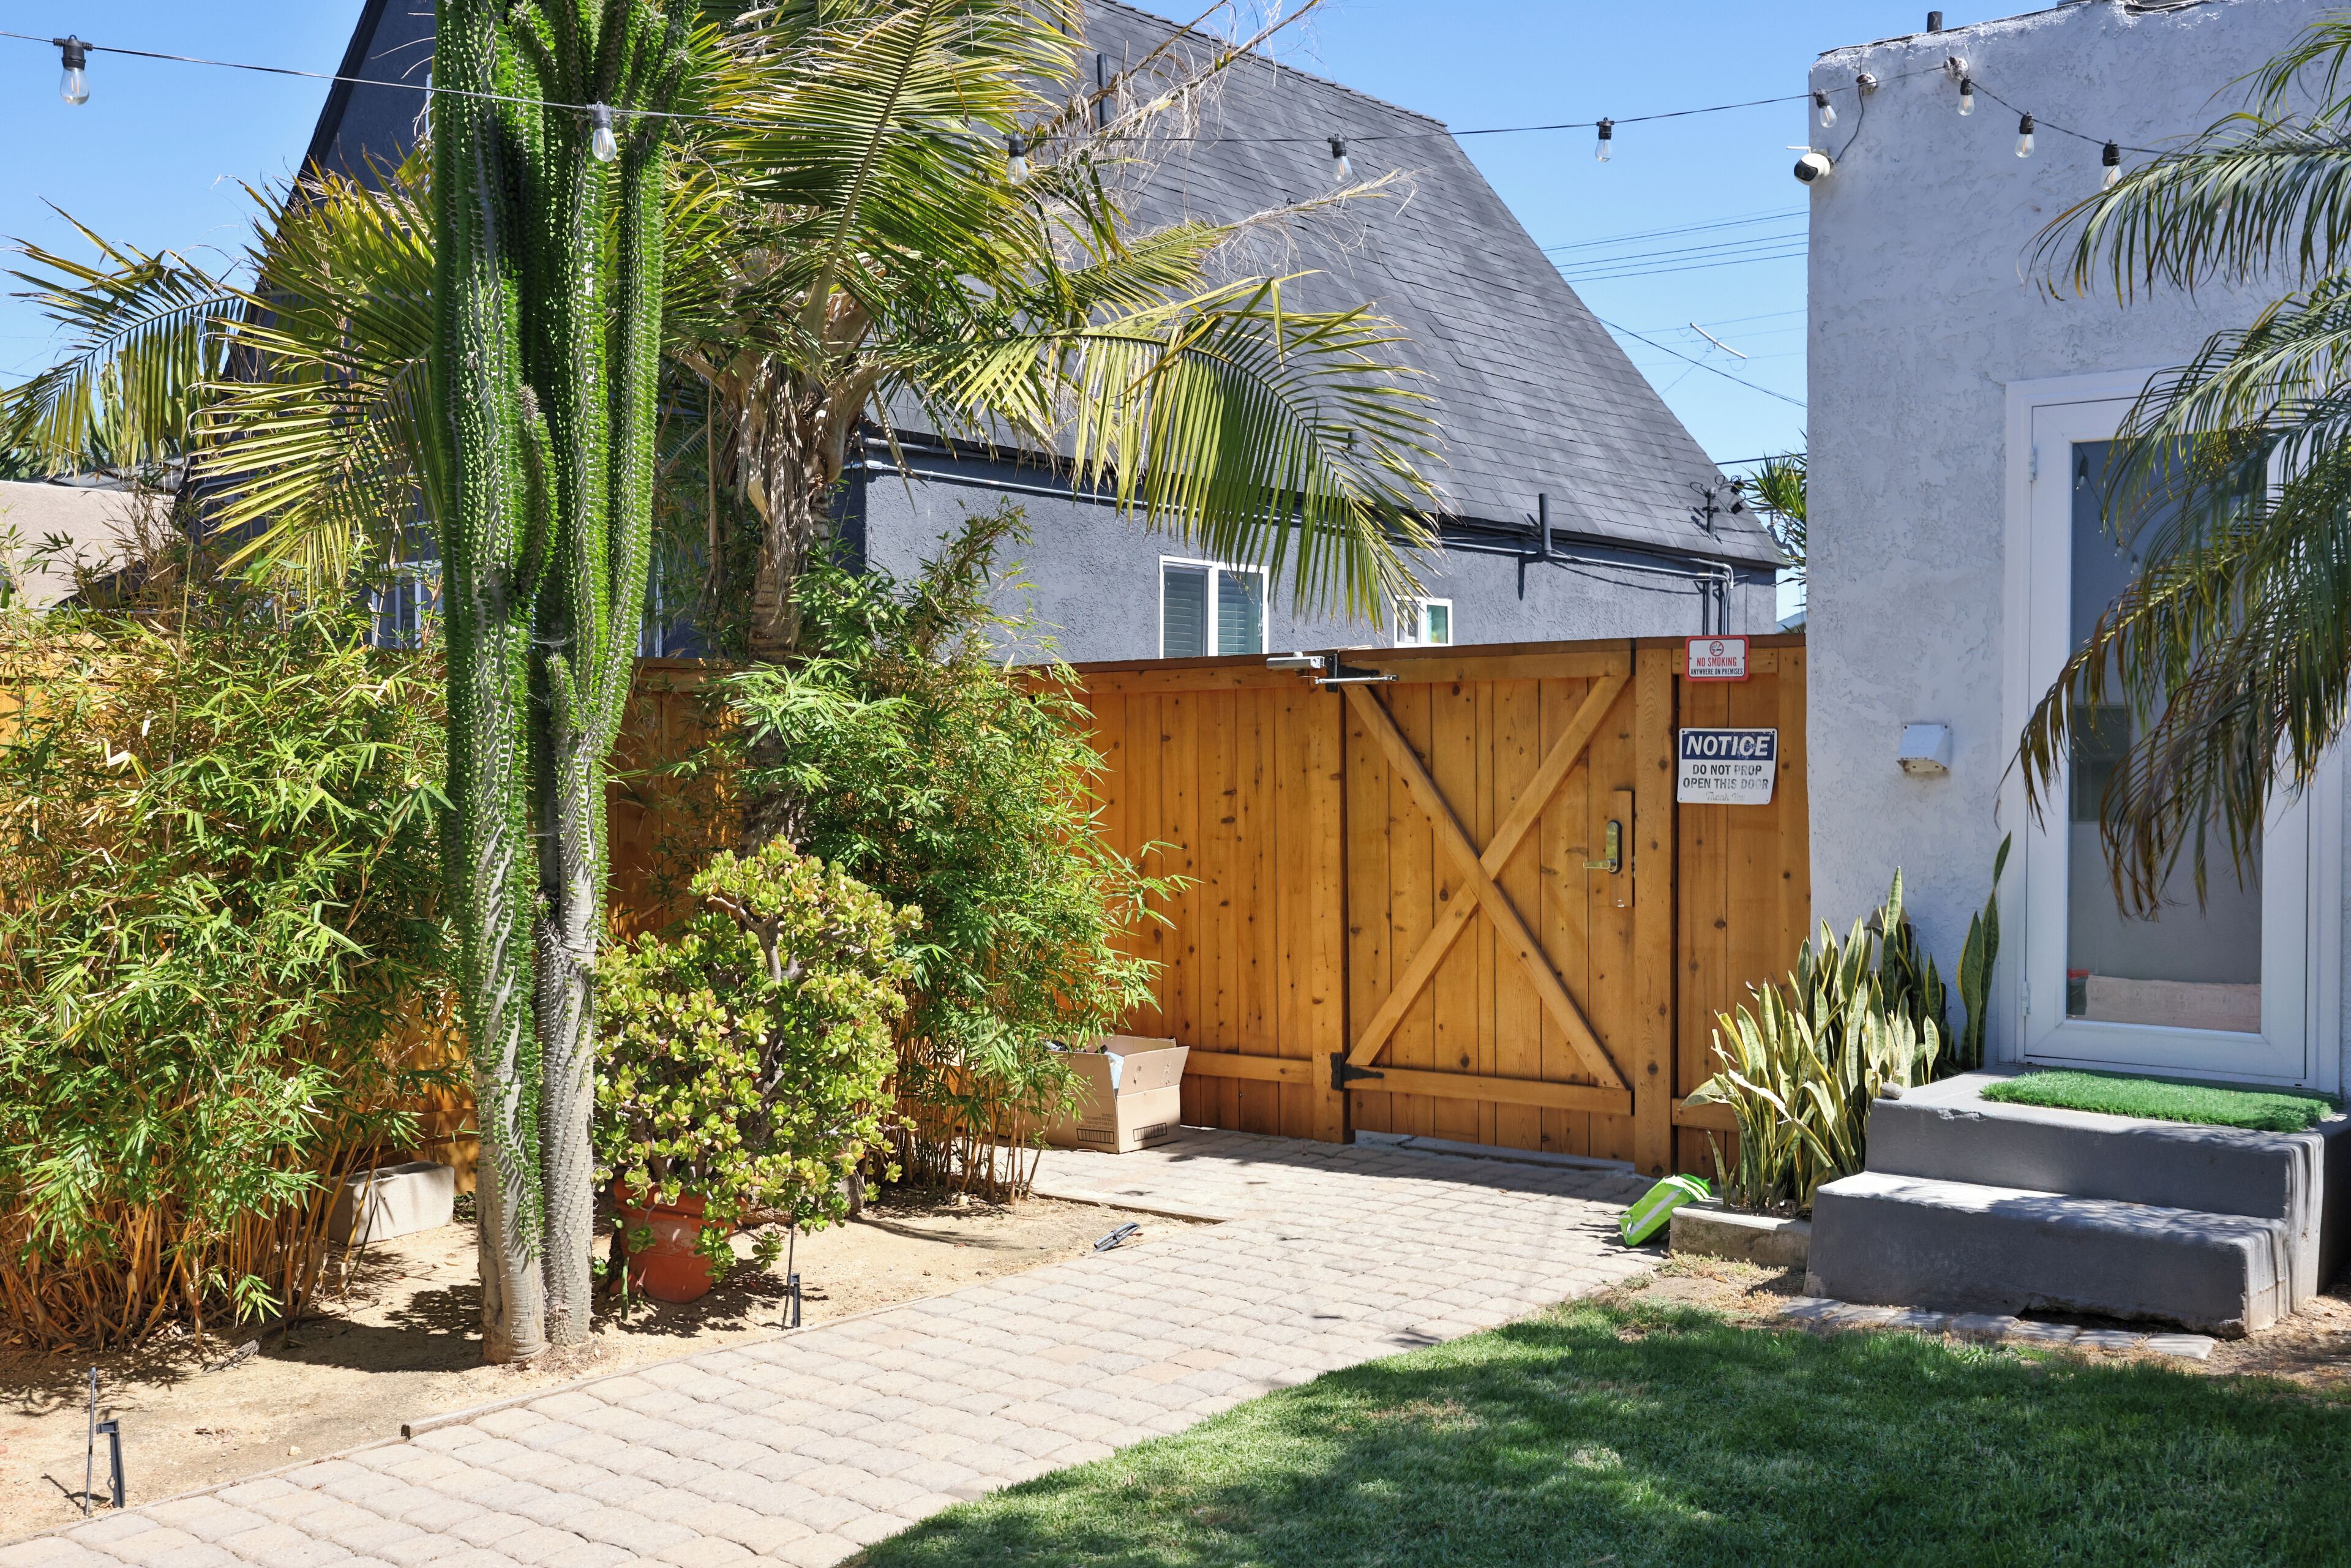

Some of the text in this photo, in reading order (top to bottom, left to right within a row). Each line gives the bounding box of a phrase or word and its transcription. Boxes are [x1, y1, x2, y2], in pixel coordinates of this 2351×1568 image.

[1697, 656, 1738, 667] NO SMOKING
[1685, 735, 1770, 756] NOTICE
[1692, 764, 1762, 776] DO NOT PROP
[1683, 778, 1769, 790] OPEN THIS DOOR
